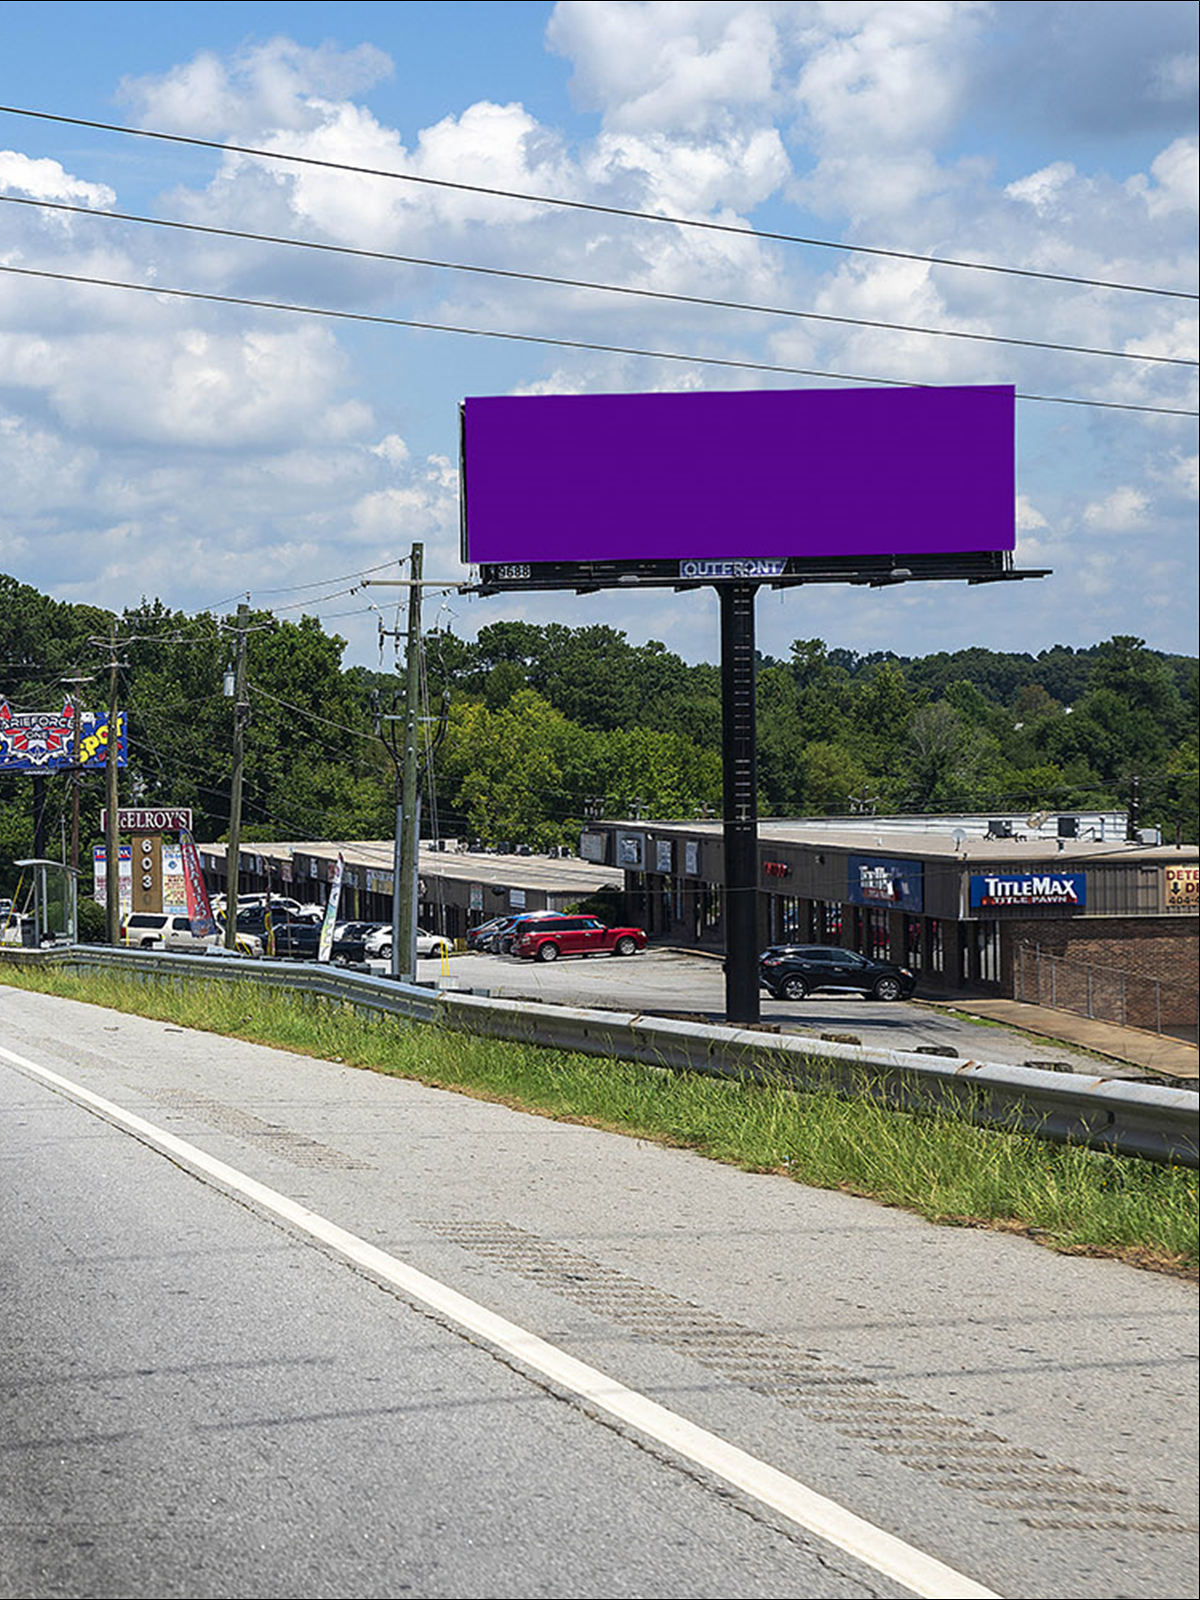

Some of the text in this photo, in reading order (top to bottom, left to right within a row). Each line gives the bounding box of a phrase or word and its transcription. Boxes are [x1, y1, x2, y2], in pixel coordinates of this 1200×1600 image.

[683, 560, 782, 577] OUTFRONT
[116, 811, 188, 828] cELROY'S
[993, 895, 1067, 904] TITLE PAWN
